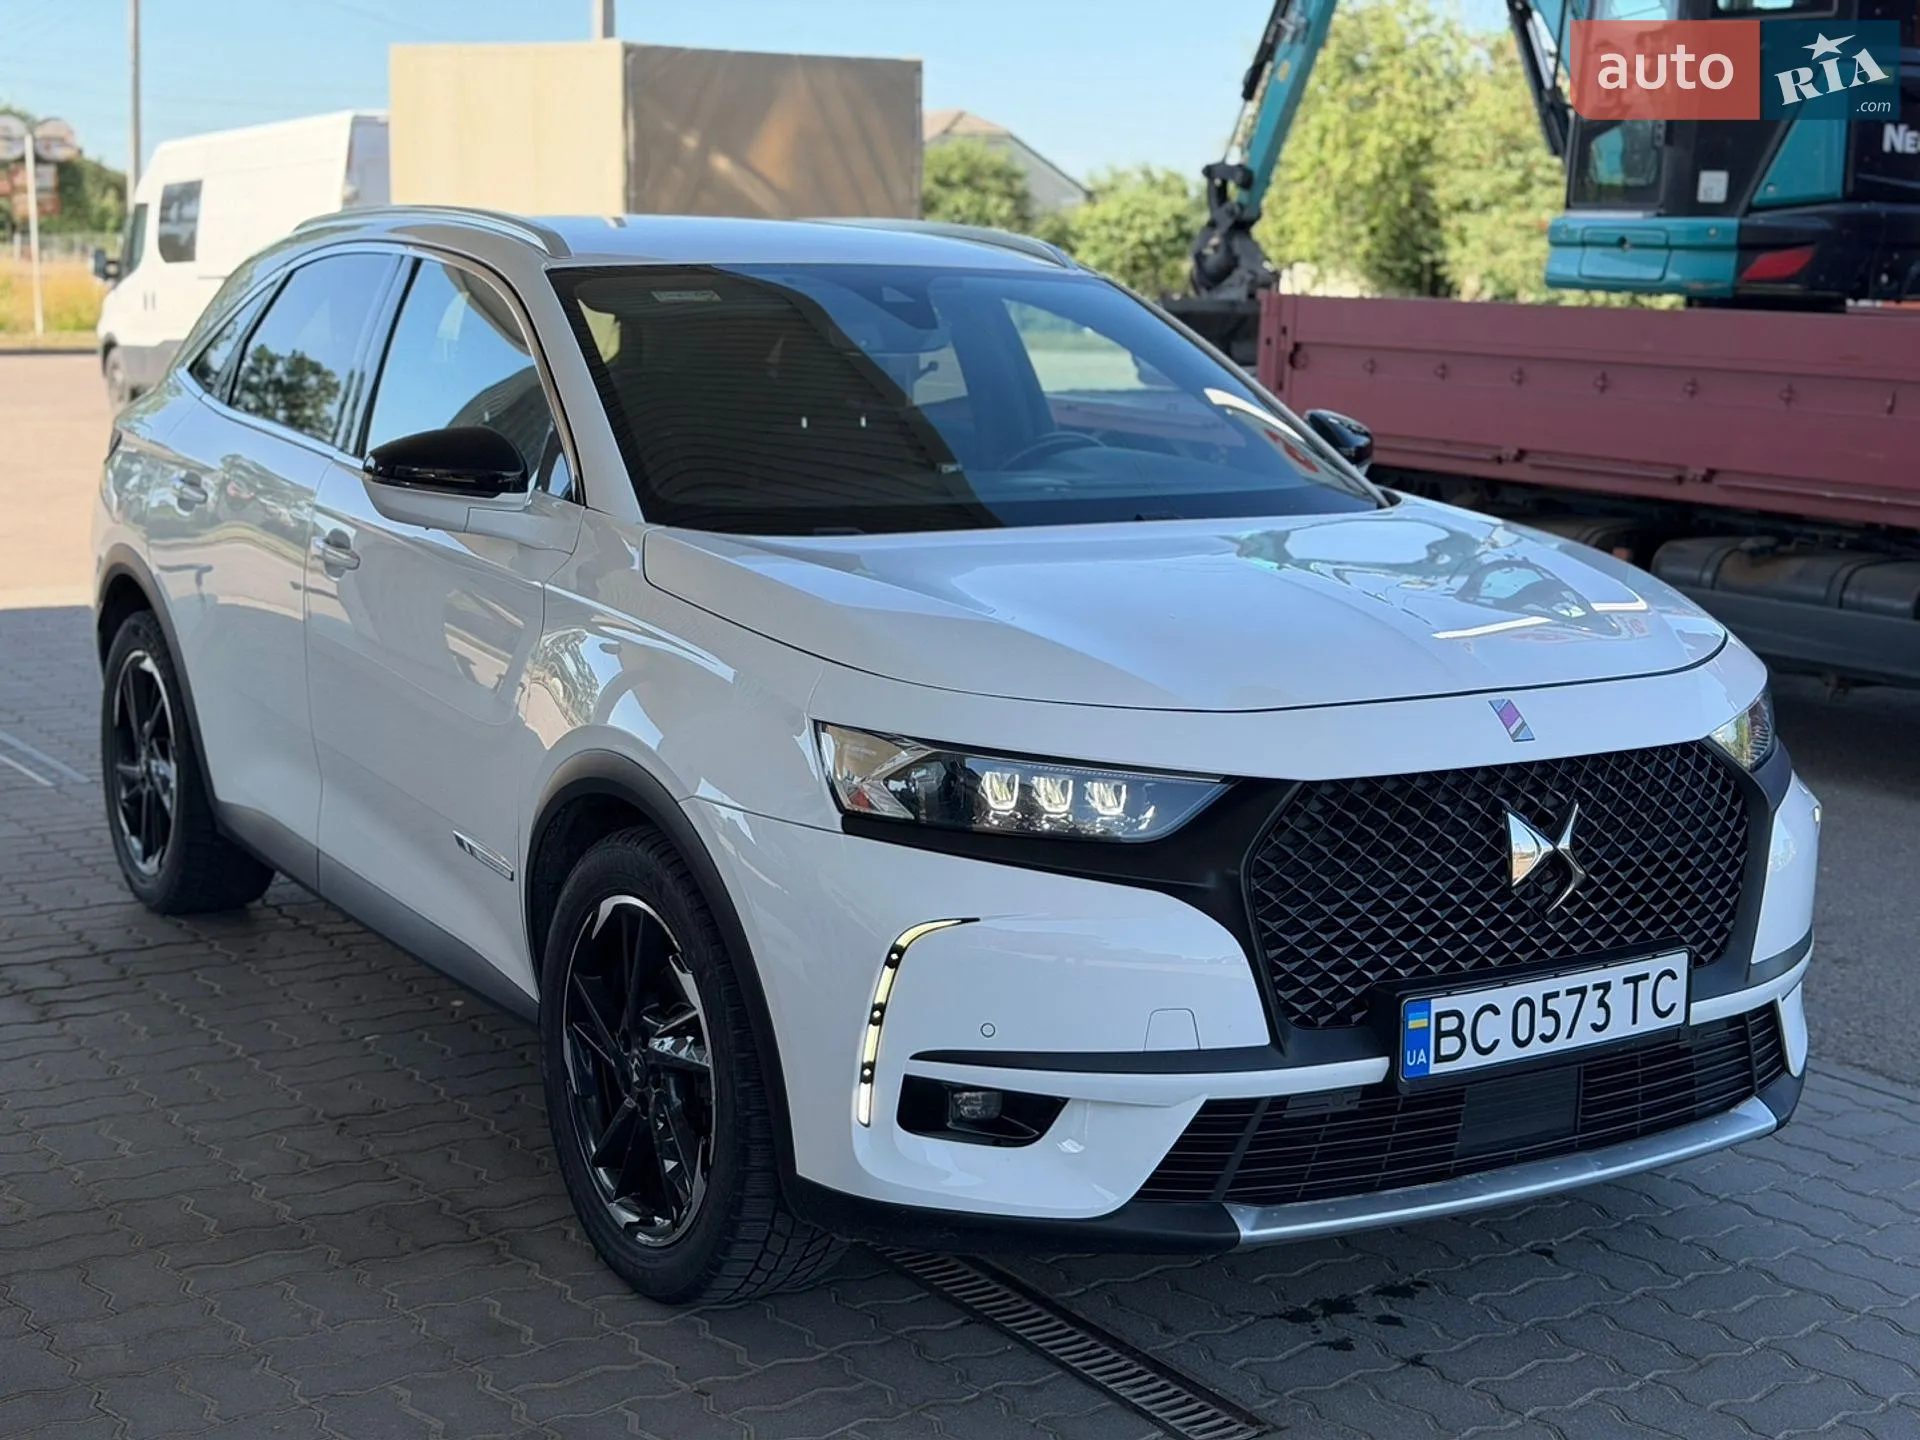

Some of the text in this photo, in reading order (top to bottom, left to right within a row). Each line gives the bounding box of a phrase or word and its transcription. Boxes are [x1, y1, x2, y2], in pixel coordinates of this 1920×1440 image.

[1882, 123, 1920, 154] NE
[1433, 968, 1678, 1064] BC 0573 TC
[1406, 1049, 1427, 1066] UA
